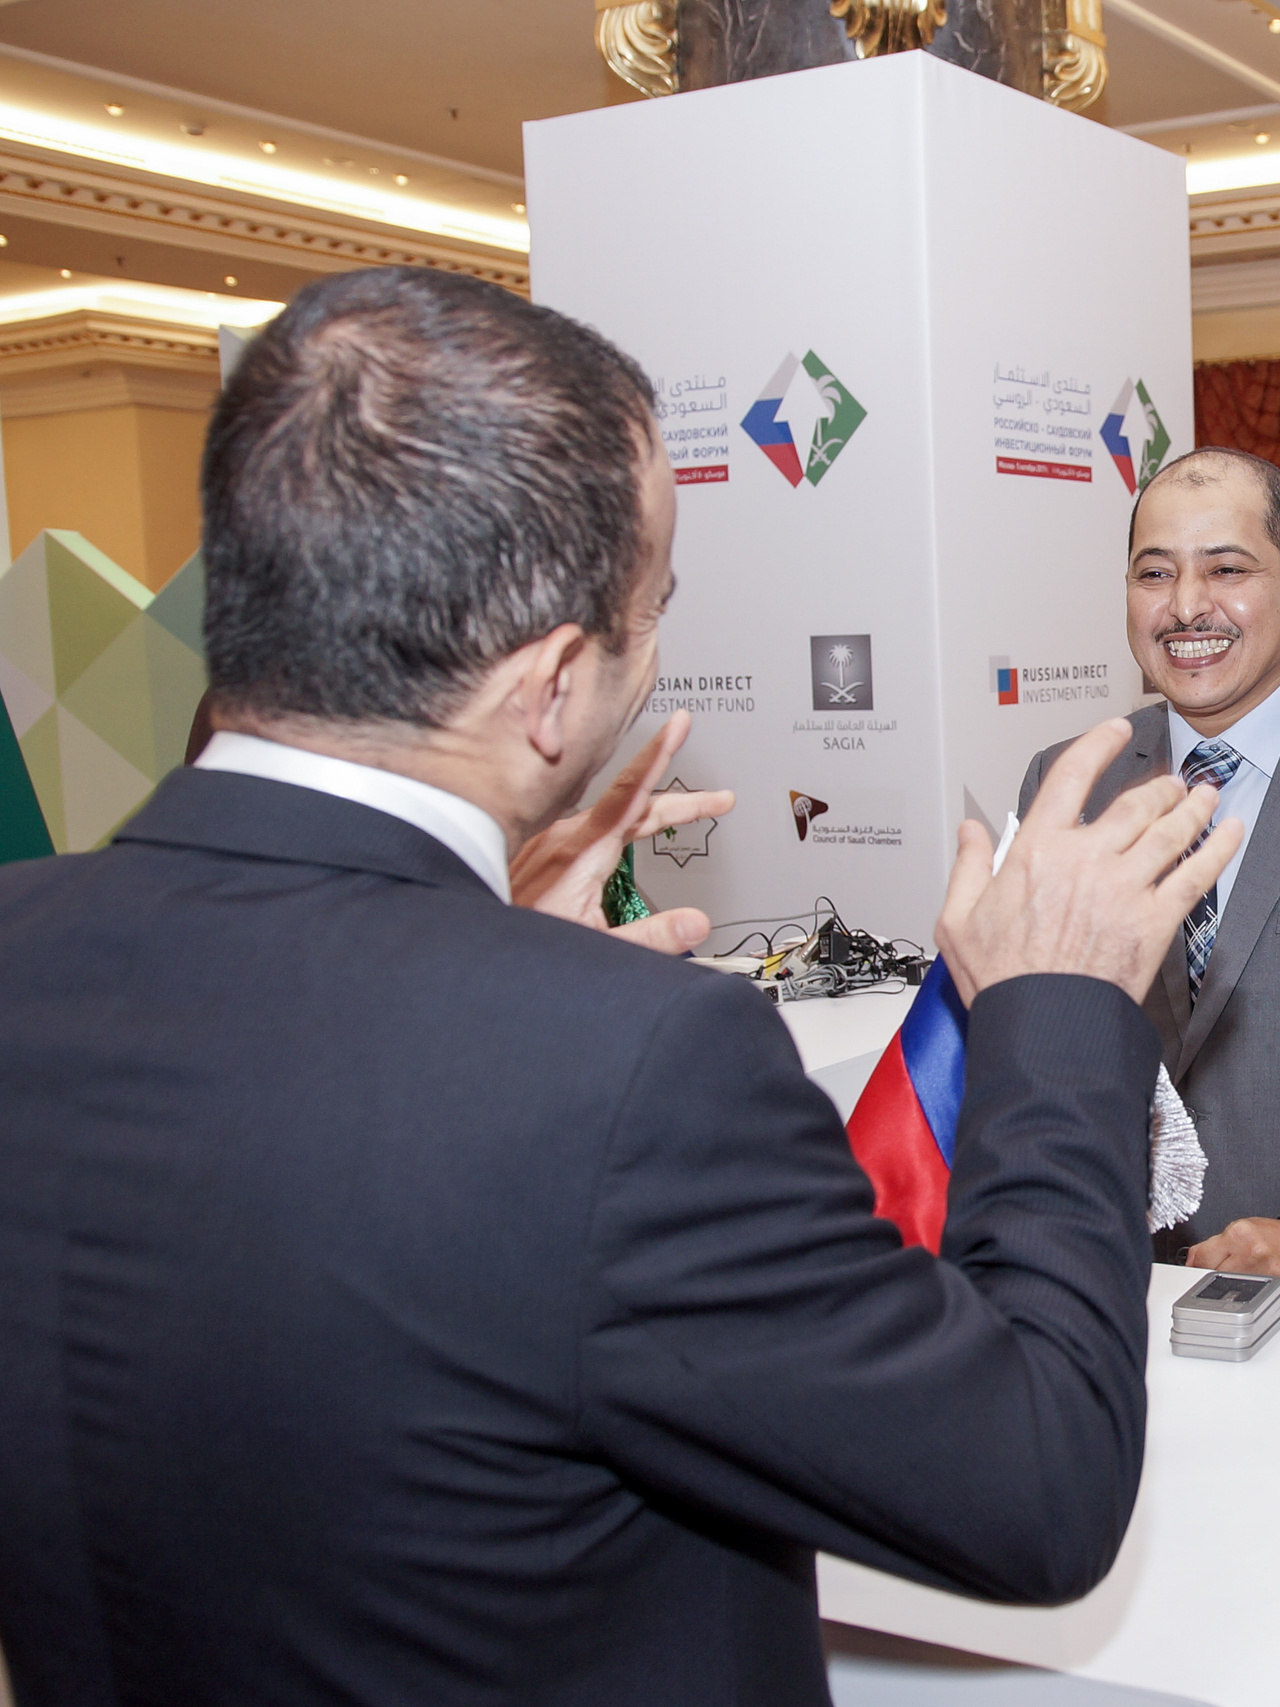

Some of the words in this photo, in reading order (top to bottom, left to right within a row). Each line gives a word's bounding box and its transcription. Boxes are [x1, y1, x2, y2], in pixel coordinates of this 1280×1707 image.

[669, 375, 727, 397] منتدى
[662, 423, 728, 441] САУДОВСКИЙ
[692, 445, 728, 459] ФОРУМ
[1023, 667, 1069, 682] RUSSIAN
[1073, 664, 1107, 679] DIRECT
[651, 677, 693, 692] SIAN
[699, 676, 752, 691] DIRECT
[1023, 685, 1082, 703] INVESTMENT
[1085, 684, 1109, 699] FUND
[644, 697, 712, 713] VESTMENT
[718, 697, 755, 712] FUND
[823, 737, 865, 750] SAGIA
[813, 834, 837, 844] Council
[839, 835, 845, 844] of
[847, 835, 866, 845] Saudi
[867, 836, 902, 846] Chambers
